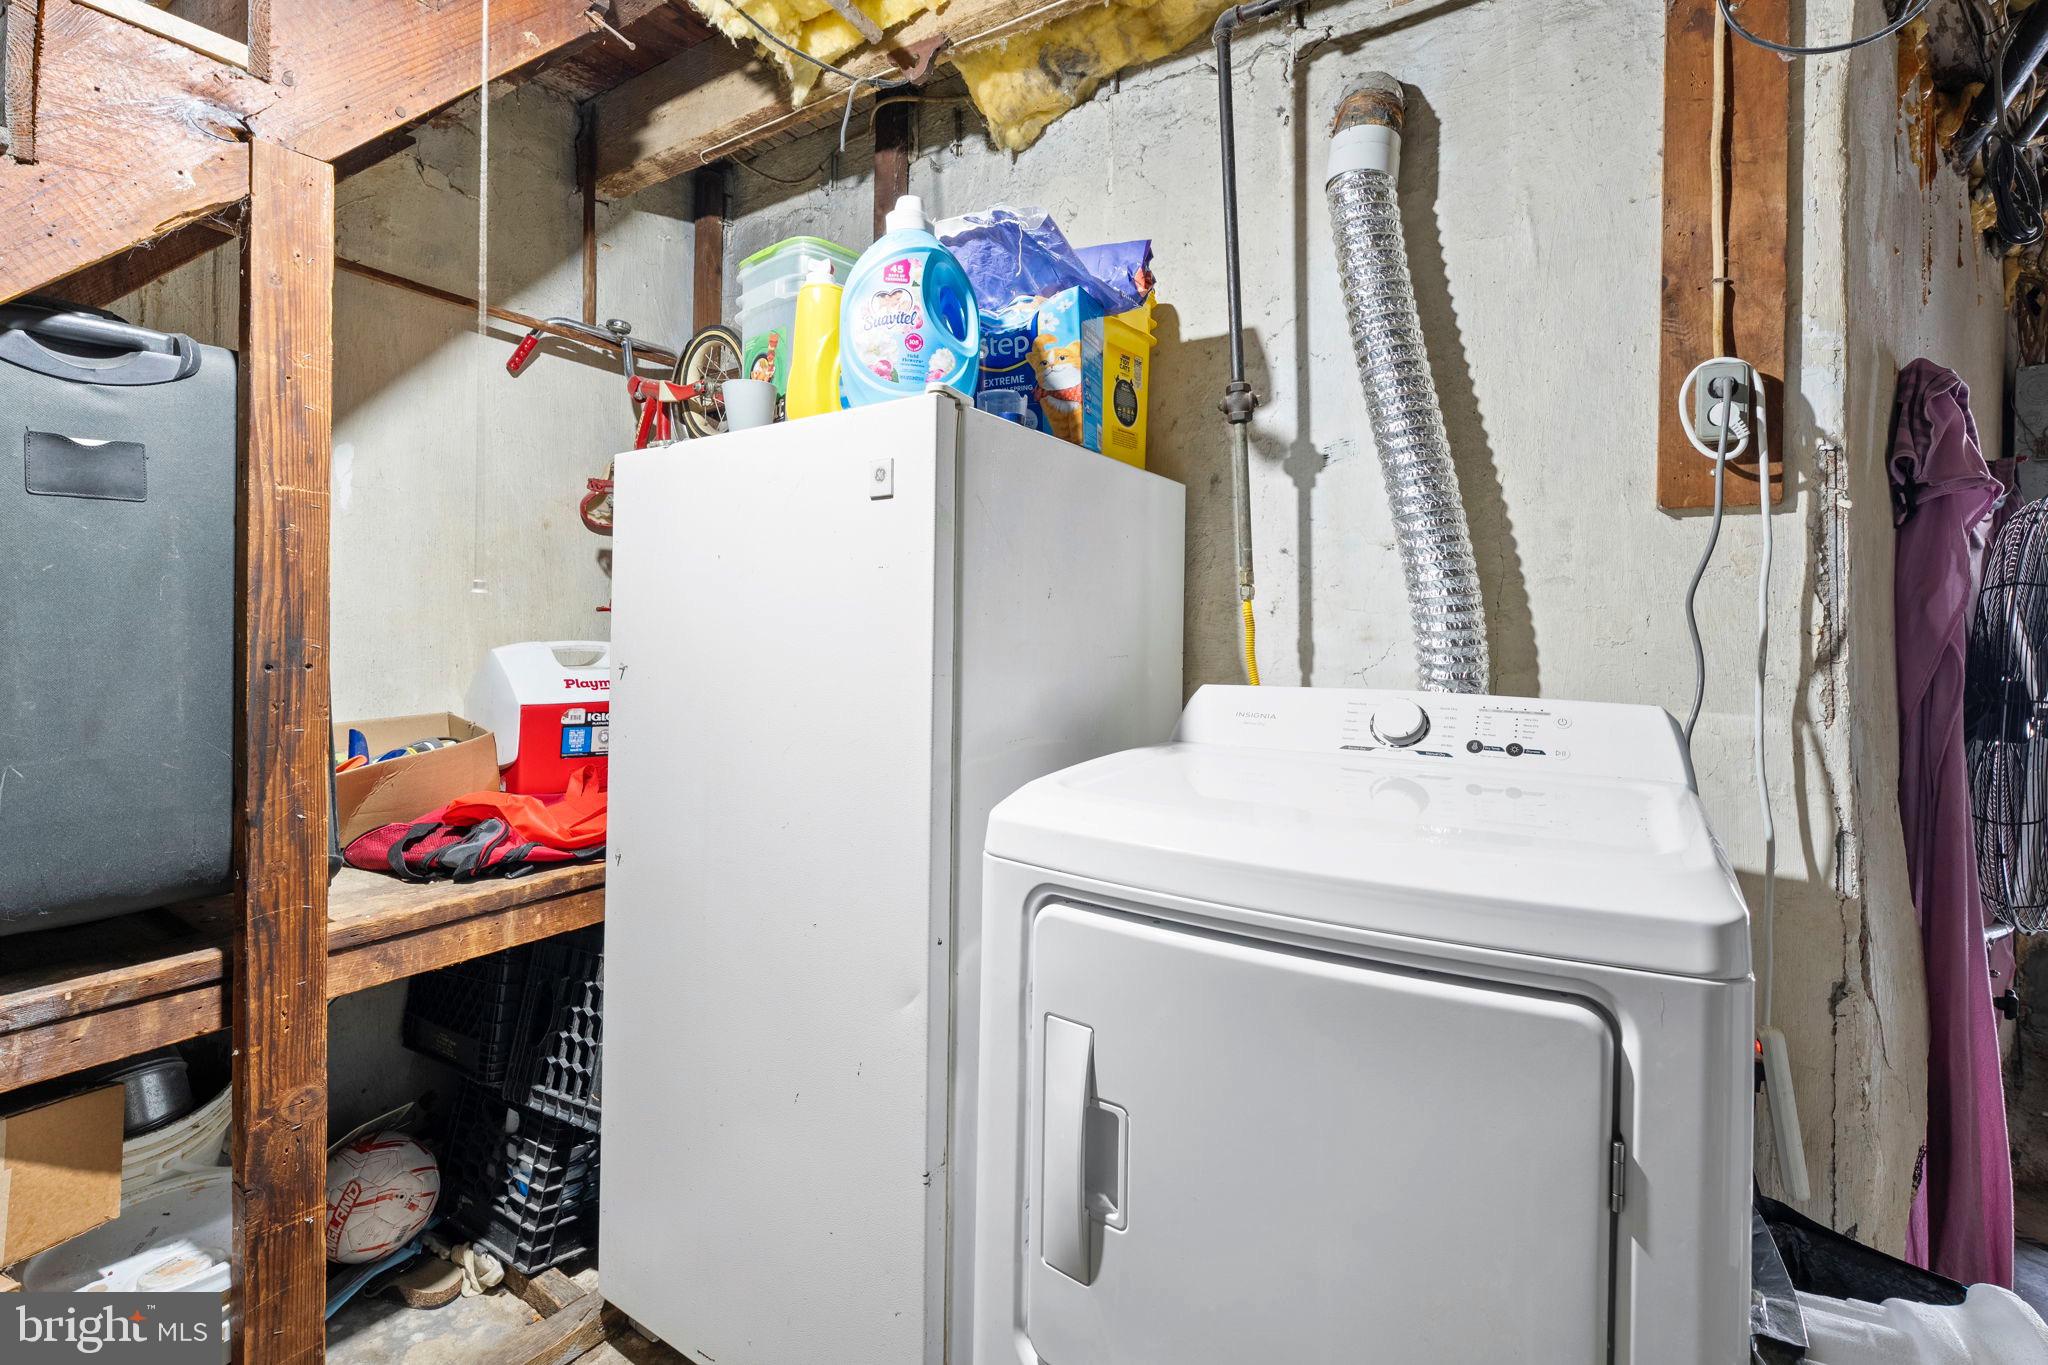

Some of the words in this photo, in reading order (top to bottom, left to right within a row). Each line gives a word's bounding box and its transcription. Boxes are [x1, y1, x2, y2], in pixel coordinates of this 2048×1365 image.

[890, 264, 904, 273] 45
[863, 311, 917, 331] Suavitel
[983, 374, 1025, 388] EXTREME
[1235, 711, 1277, 720] INSIGNIA
